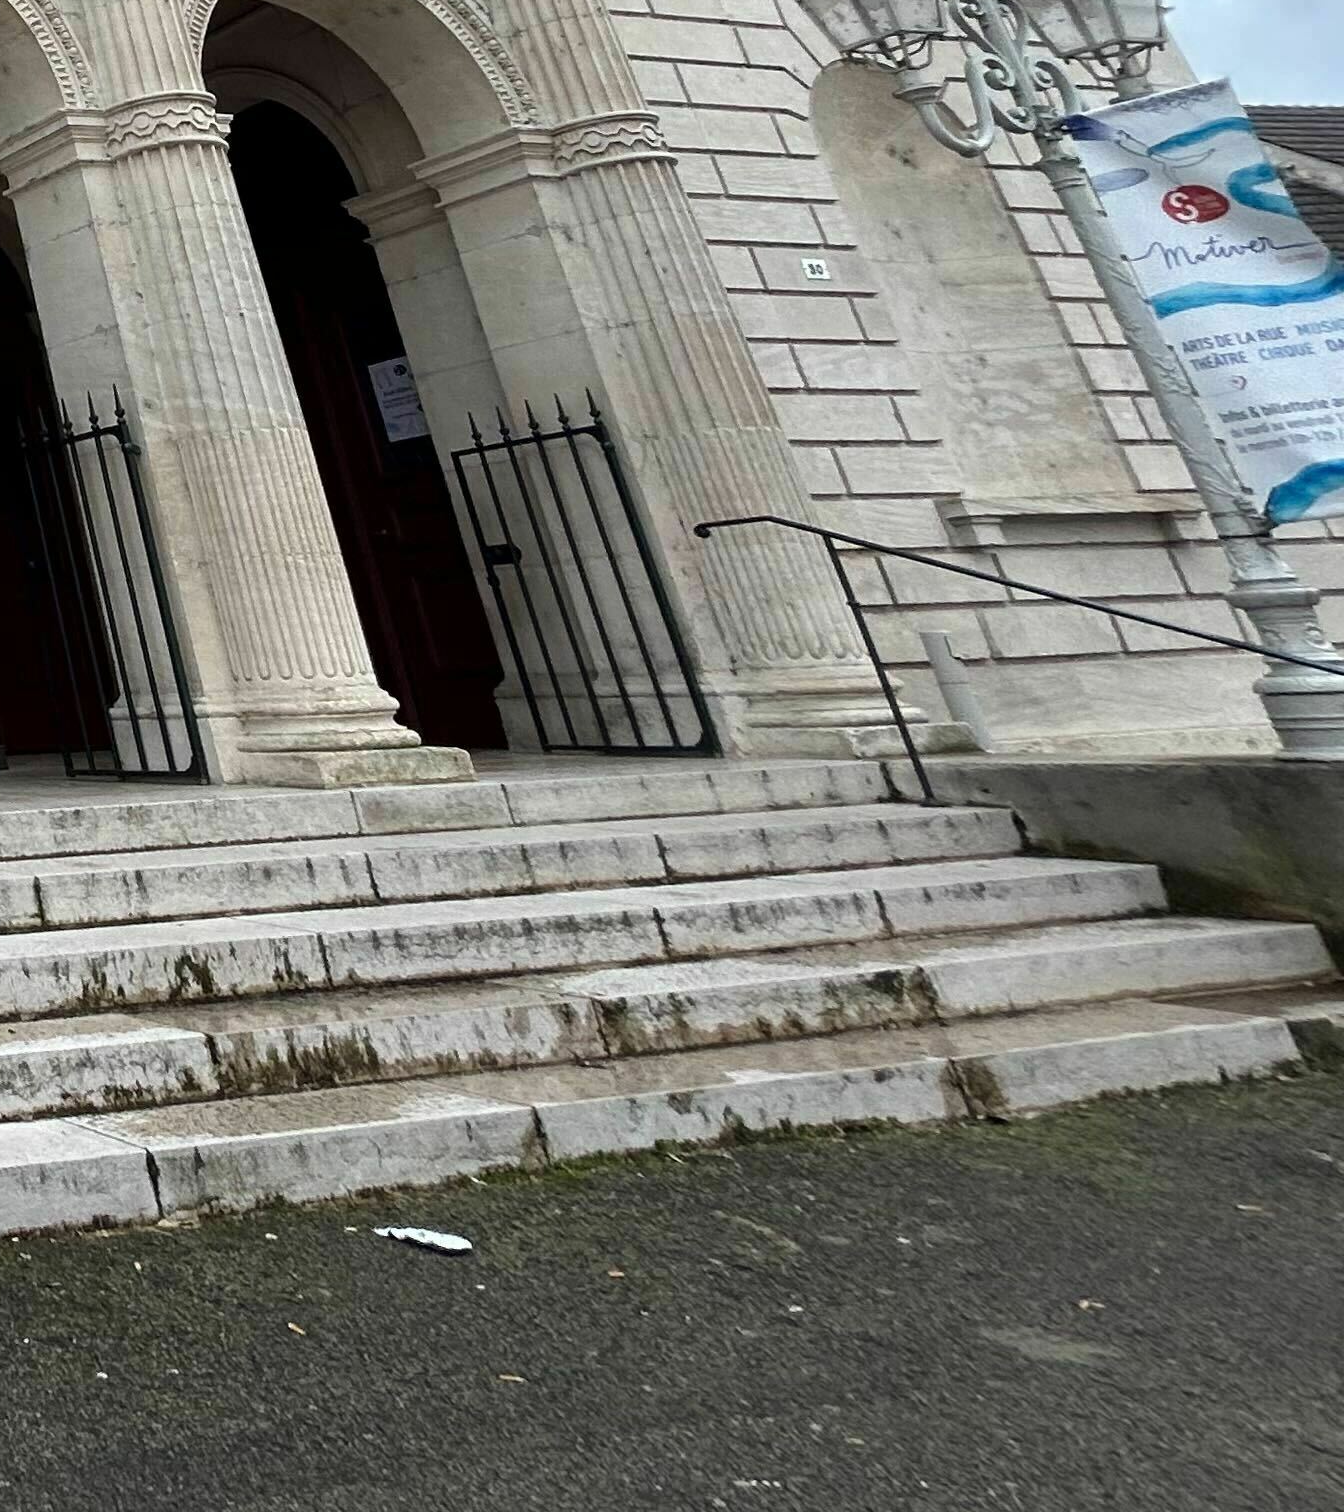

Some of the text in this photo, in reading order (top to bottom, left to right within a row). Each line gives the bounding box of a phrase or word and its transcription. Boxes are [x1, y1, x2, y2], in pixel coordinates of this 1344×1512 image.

[1182, 337, 1214, 354] ARTS
[1213, 333, 1235, 349] DE
[1234, 331, 1257, 346] LA
[1256, 326, 1288, 342] RUE
